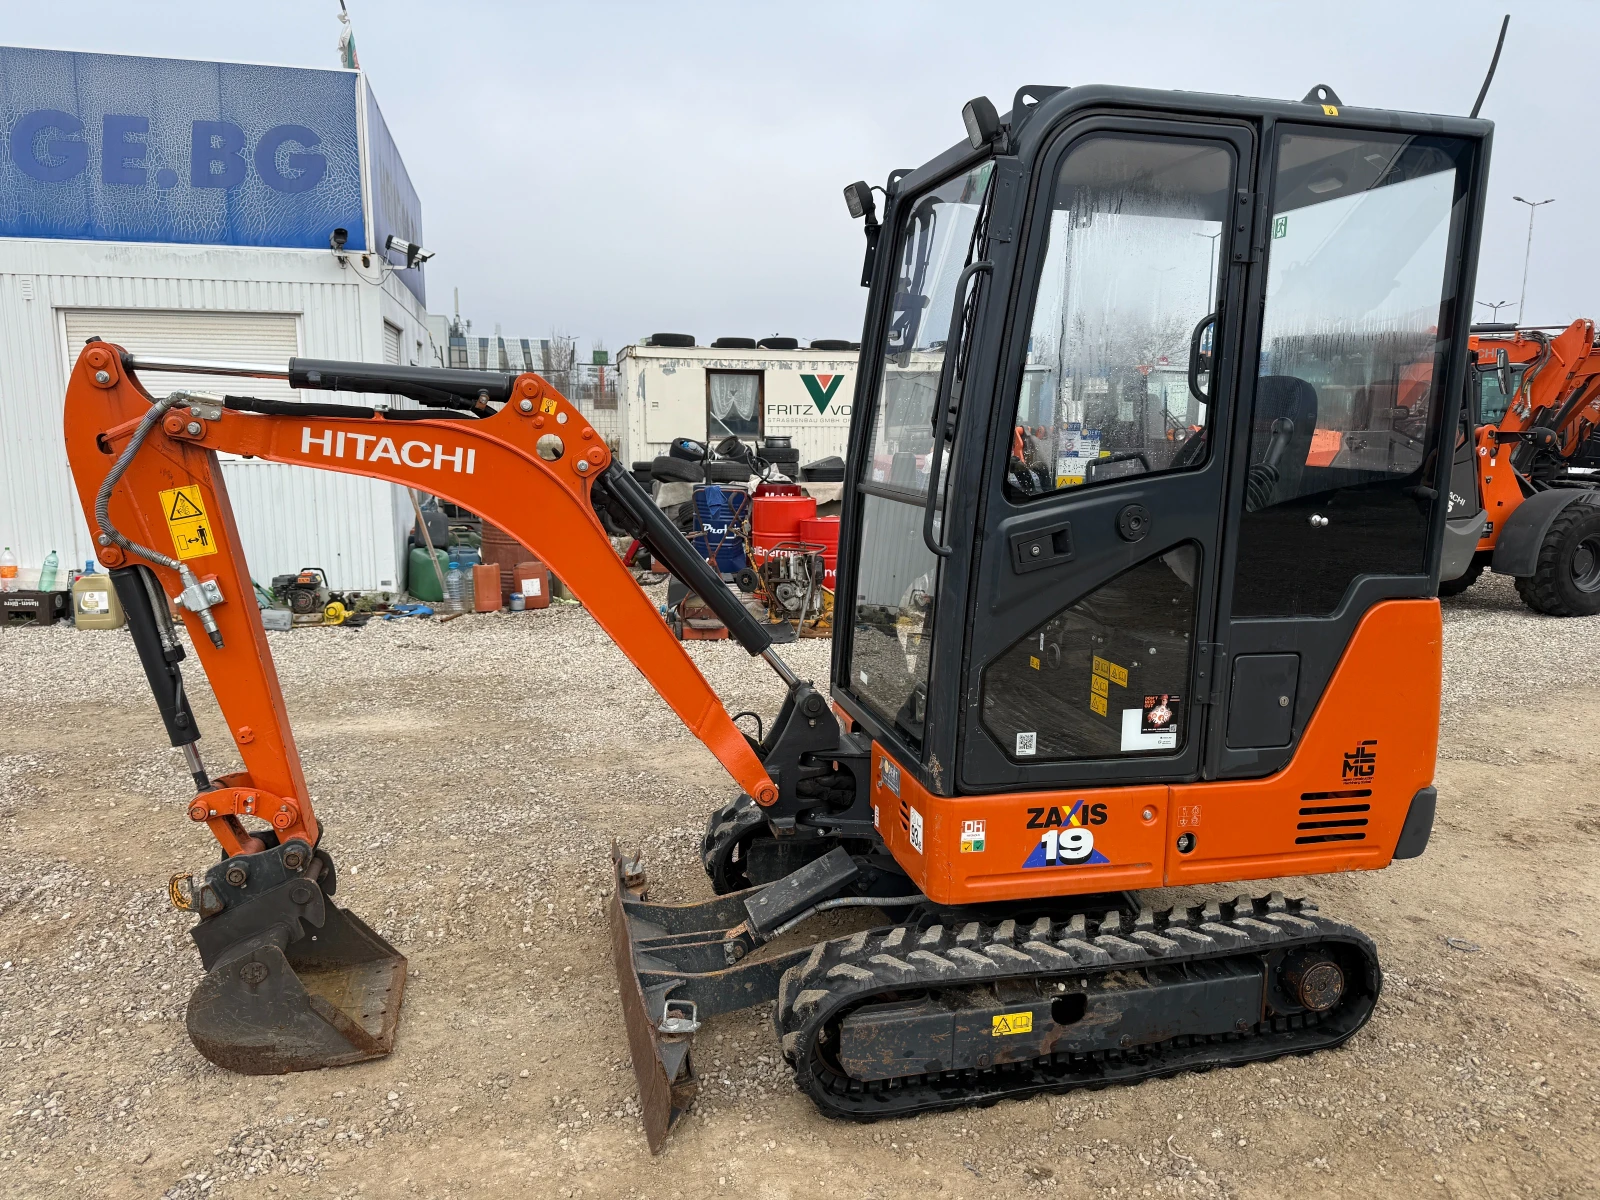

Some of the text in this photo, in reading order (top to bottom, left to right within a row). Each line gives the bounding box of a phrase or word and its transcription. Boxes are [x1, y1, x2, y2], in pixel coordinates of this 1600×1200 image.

[10, 109, 327, 194] GE.BG
[767, 404, 814, 416] FRITZ
[300, 426, 476, 475] HITACHI
[1026, 800, 1108, 829] ZAXIS
[1041, 828, 1095, 865] 19
